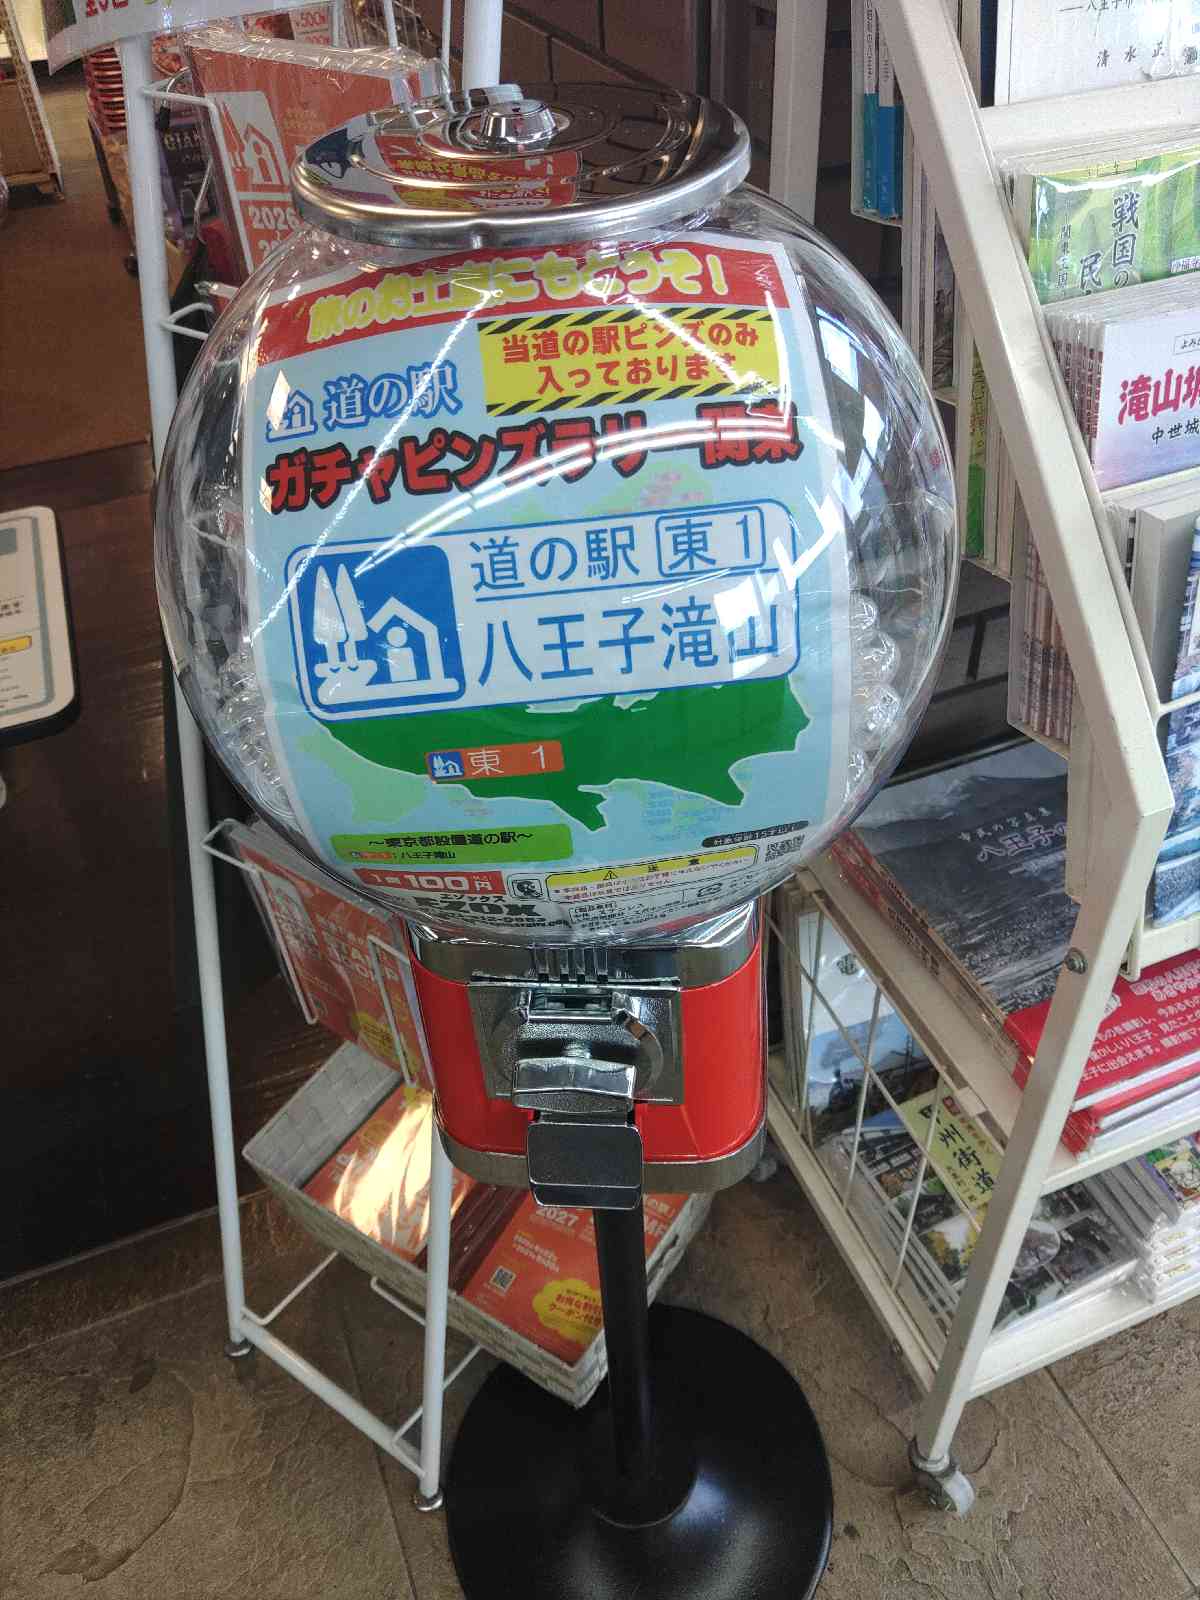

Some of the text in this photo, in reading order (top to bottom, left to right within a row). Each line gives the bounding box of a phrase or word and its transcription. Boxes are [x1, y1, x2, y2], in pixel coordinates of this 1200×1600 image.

[502, 321, 760, 364] 当道の駅ピンズのみ
[536, 355, 737, 395] 入っております
[323, 359, 463, 432] 道の駅
[469, 525, 641, 592] 道の駅
[477, 595, 781, 687] 八王子滝山
